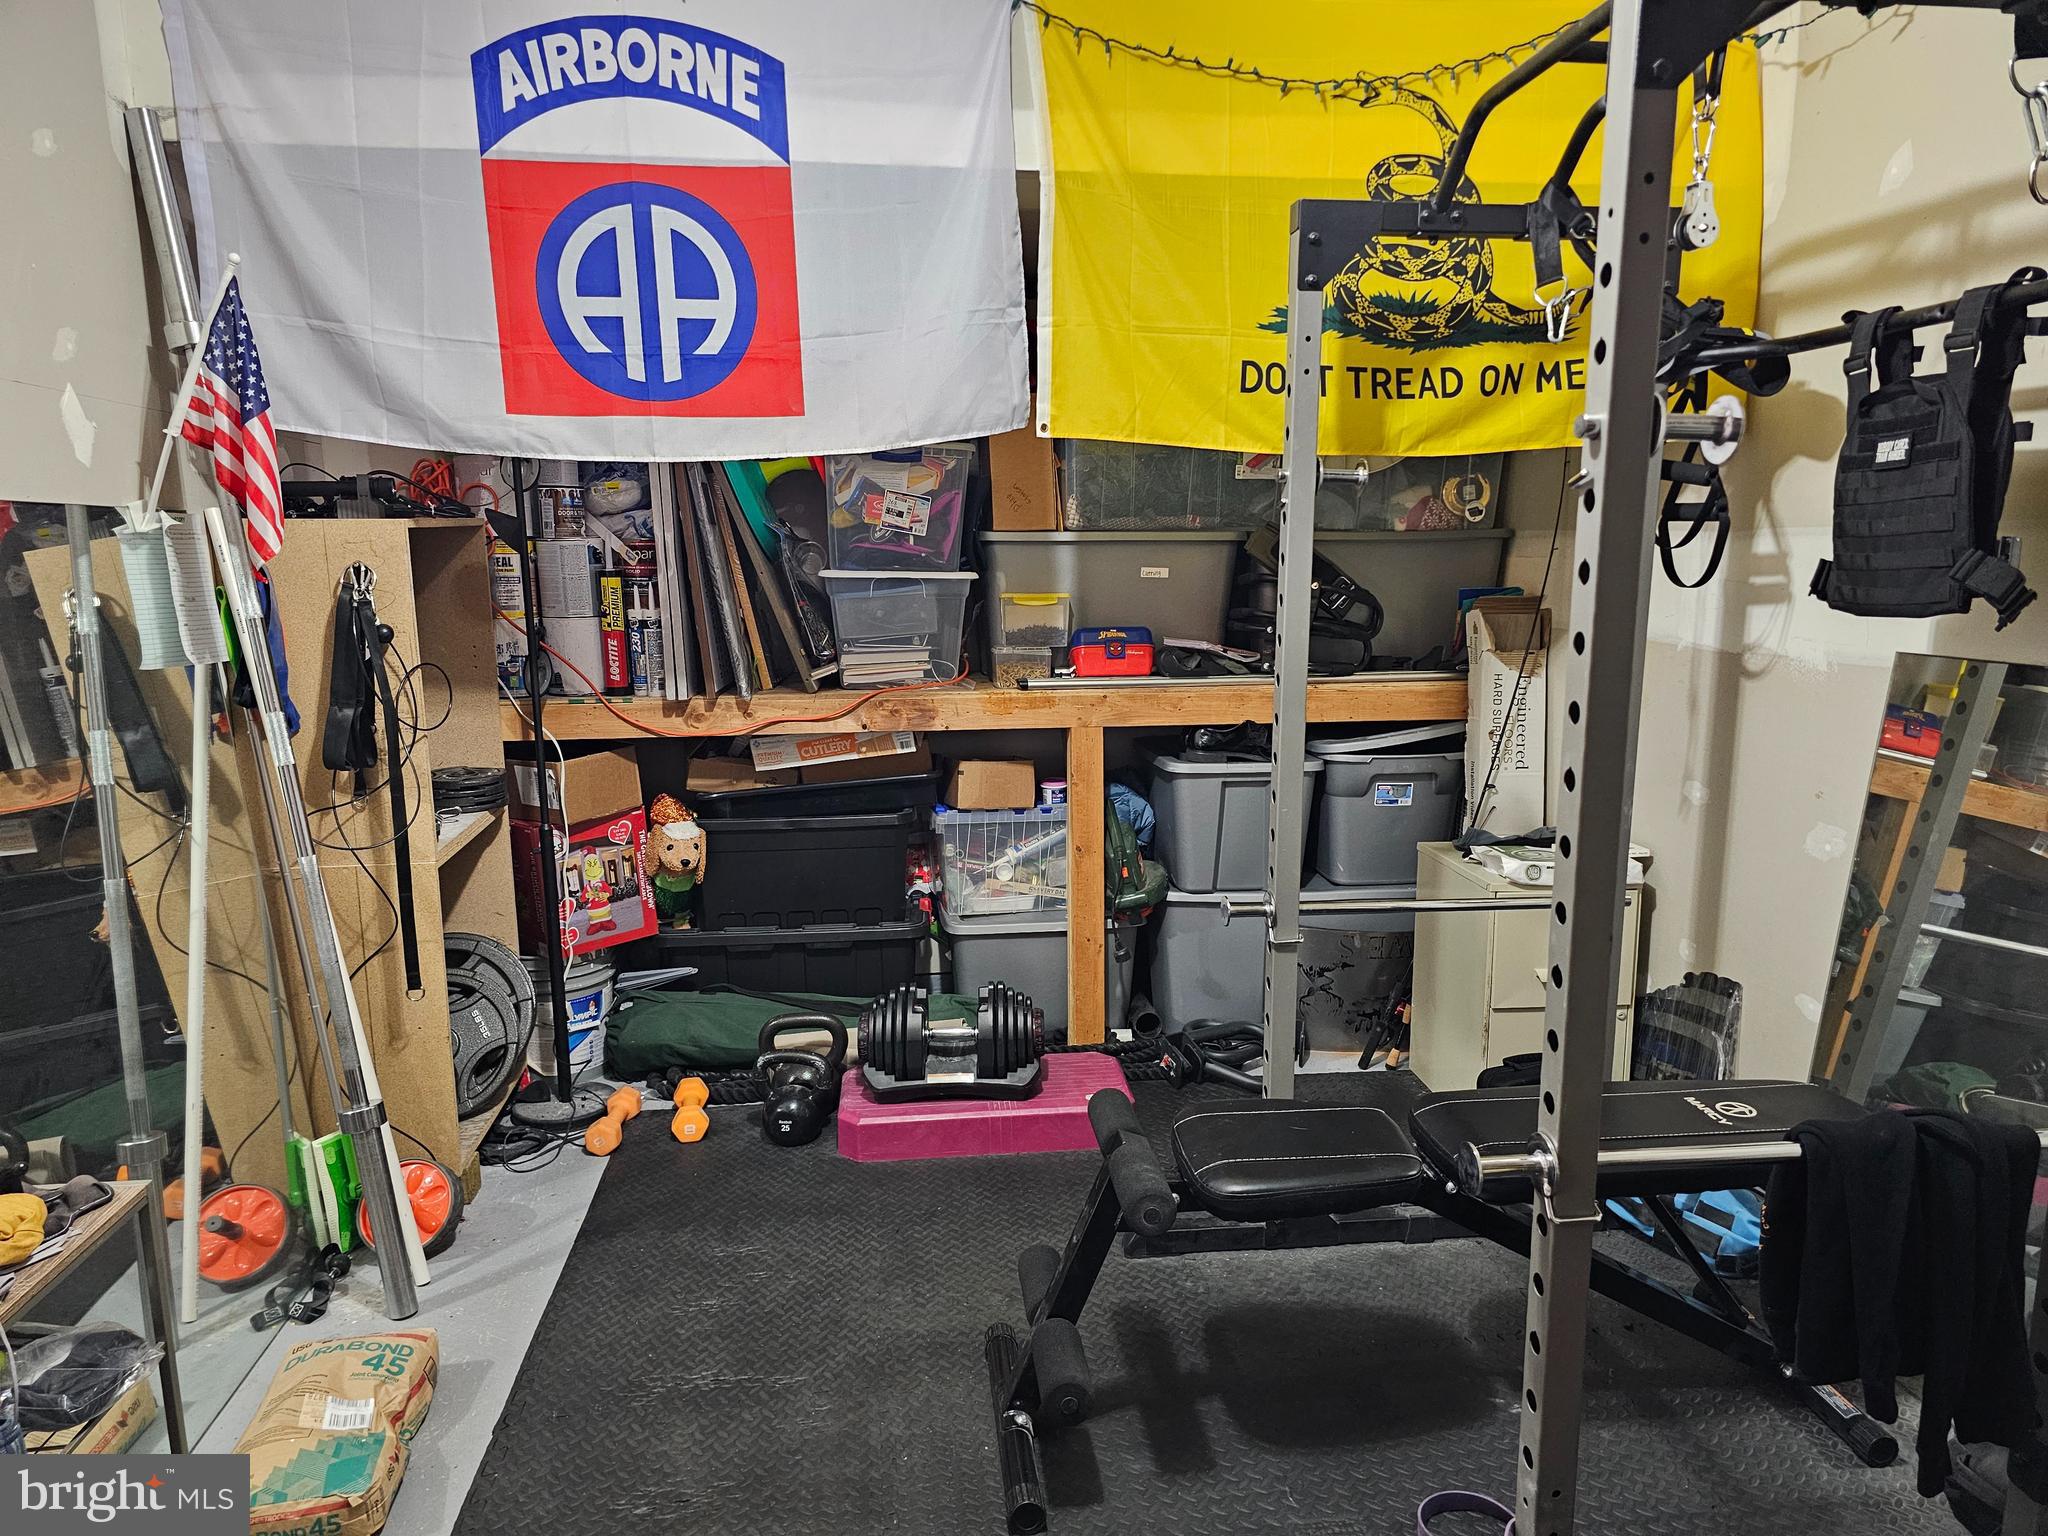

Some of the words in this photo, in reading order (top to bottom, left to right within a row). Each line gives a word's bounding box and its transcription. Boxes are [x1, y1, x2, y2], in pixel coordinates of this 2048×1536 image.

[498, 27, 760, 121] AIRBORNE
[556, 202, 738, 384] AA
[1240, 359, 1333, 399] DOT
[1346, 365, 1464, 400] TREAD
[1479, 362, 1524, 397] ON
[1535, 357, 1586, 394] ME
[611, 586, 622, 629] PREMIUM
[631, 632, 642, 653] 230
[608, 637, 620, 682] LOCTITE
[1492, 672, 1503, 706] HARD
[1514, 674, 1532, 771] Engineered
[800, 738, 852, 758] CUTLERY
[1683, 1096, 1734, 1126] MARCY
[780, 1124, 791, 1132] 25
[283, 1340, 415, 1373] DURABOND
[291, 1342, 313, 1355] USG
[361, 1352, 410, 1378] 45
[309, 1513, 342, 1536] 45
